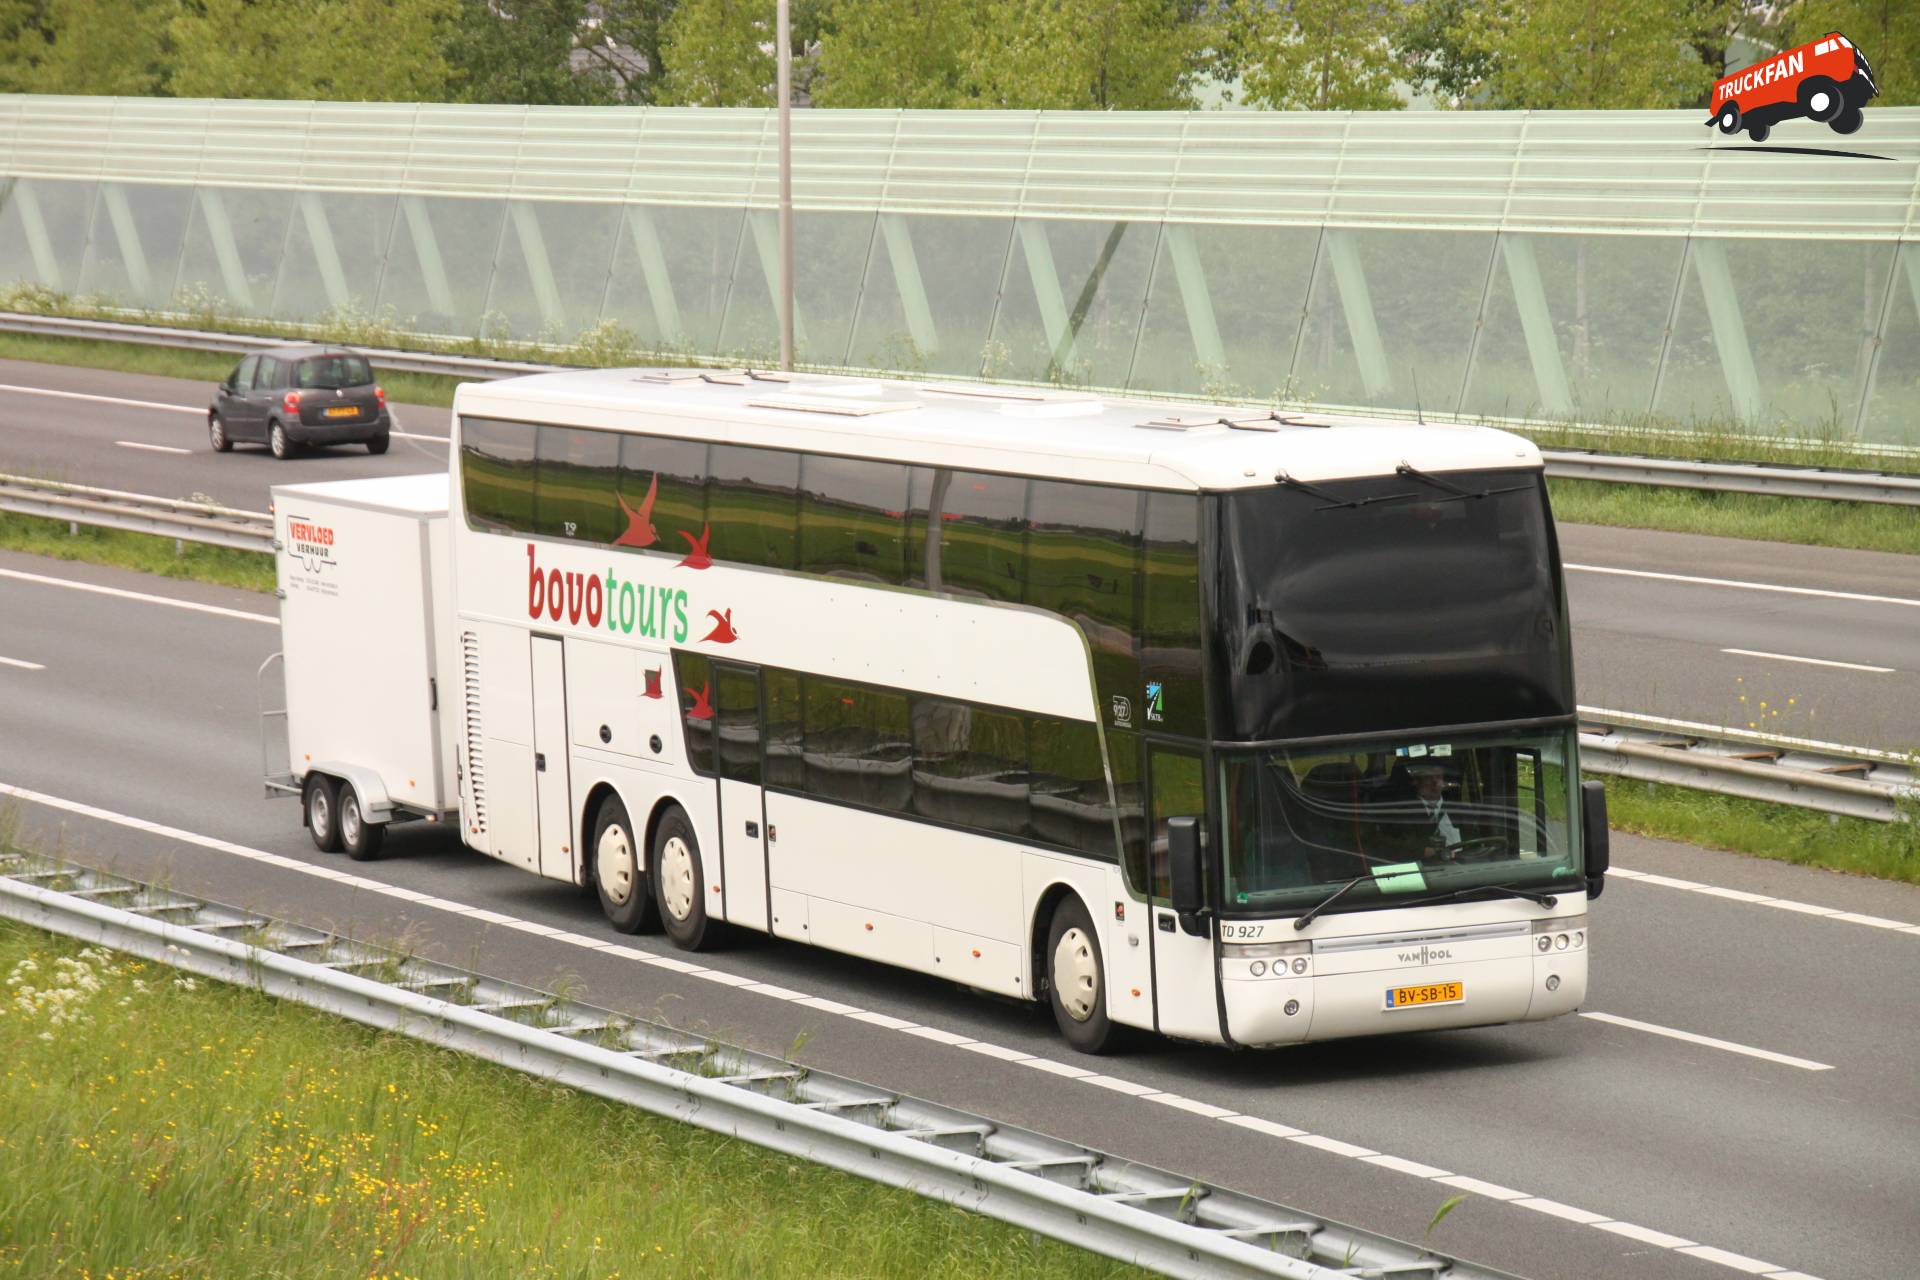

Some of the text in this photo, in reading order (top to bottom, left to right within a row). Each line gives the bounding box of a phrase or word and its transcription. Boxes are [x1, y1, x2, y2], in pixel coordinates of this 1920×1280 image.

[290, 522, 333, 545] VERVLOED
[296, 543, 329, 557] VERHUUR
[1221, 925, 1264, 937] TD 927
[1399, 985, 1456, 1003] BV-SB-15
